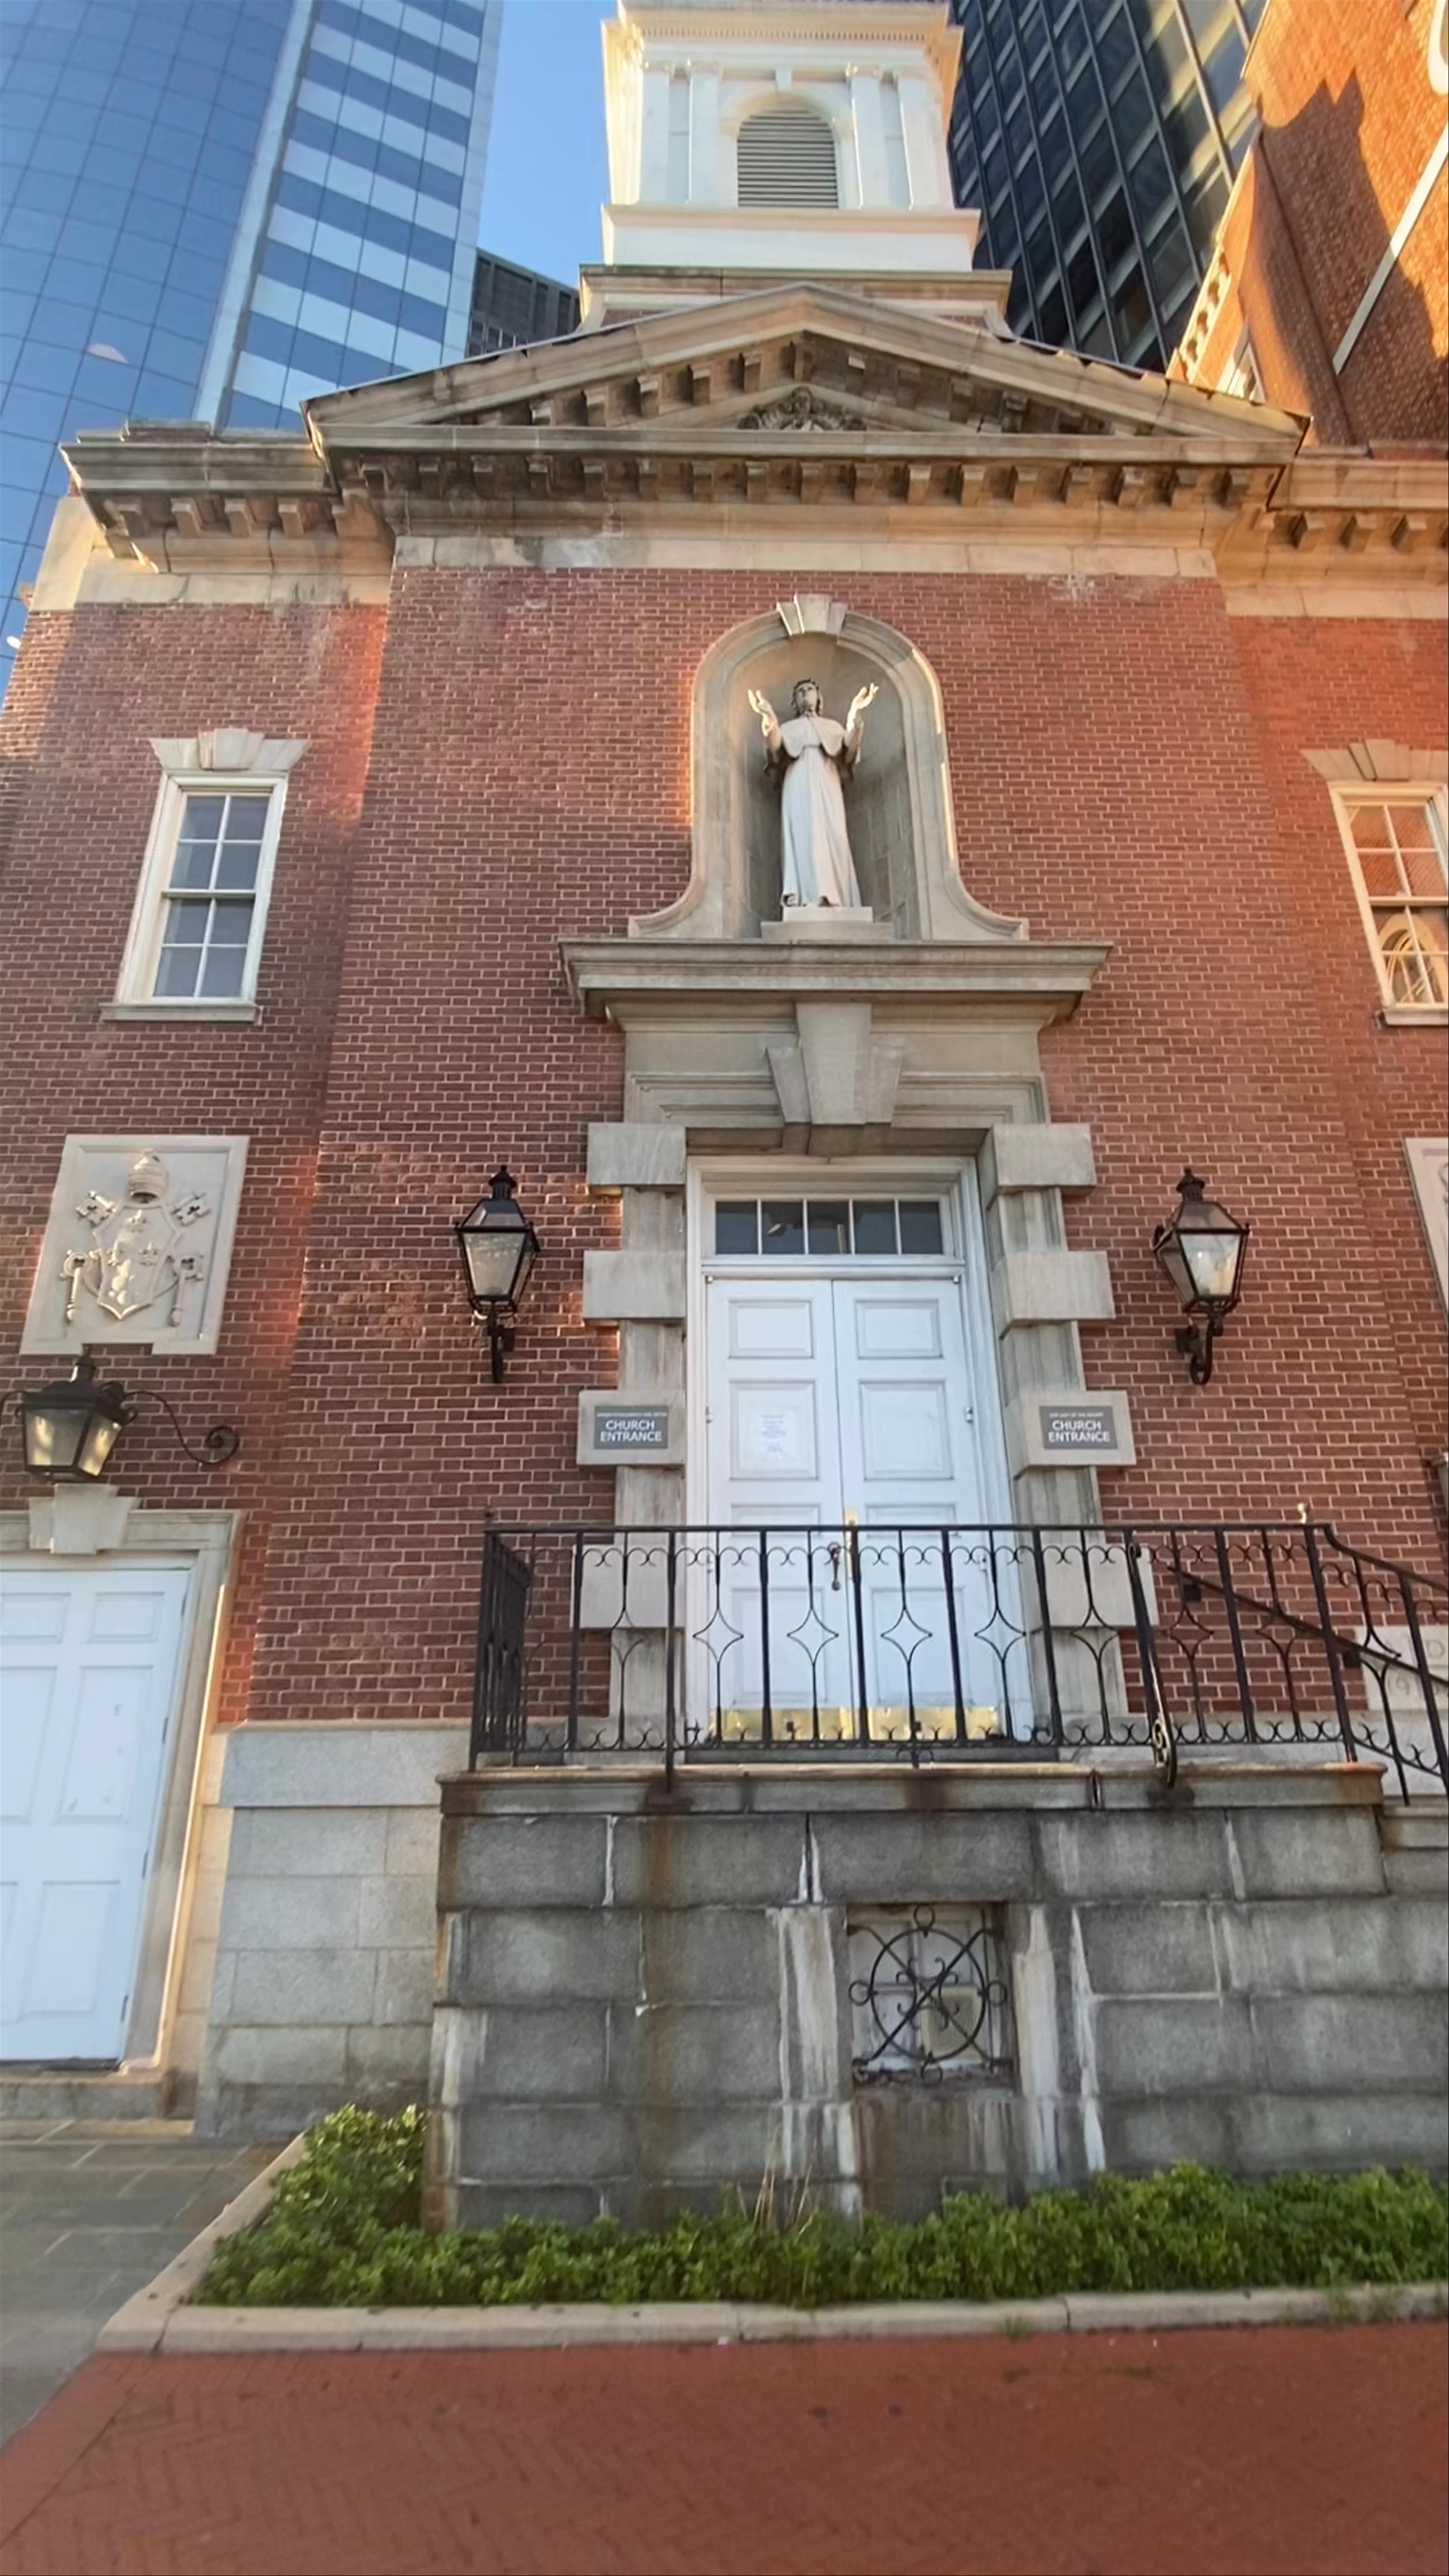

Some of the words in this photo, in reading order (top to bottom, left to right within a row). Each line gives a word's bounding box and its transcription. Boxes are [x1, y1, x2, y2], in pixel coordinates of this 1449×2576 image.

[606, 1420, 655, 1430] CHURCH
[1052, 1420, 1101, 1430] CHURCH
[600, 1431, 662, 1442] ENTRANCE
[1048, 1431, 1110, 1442] ENTRANCE
